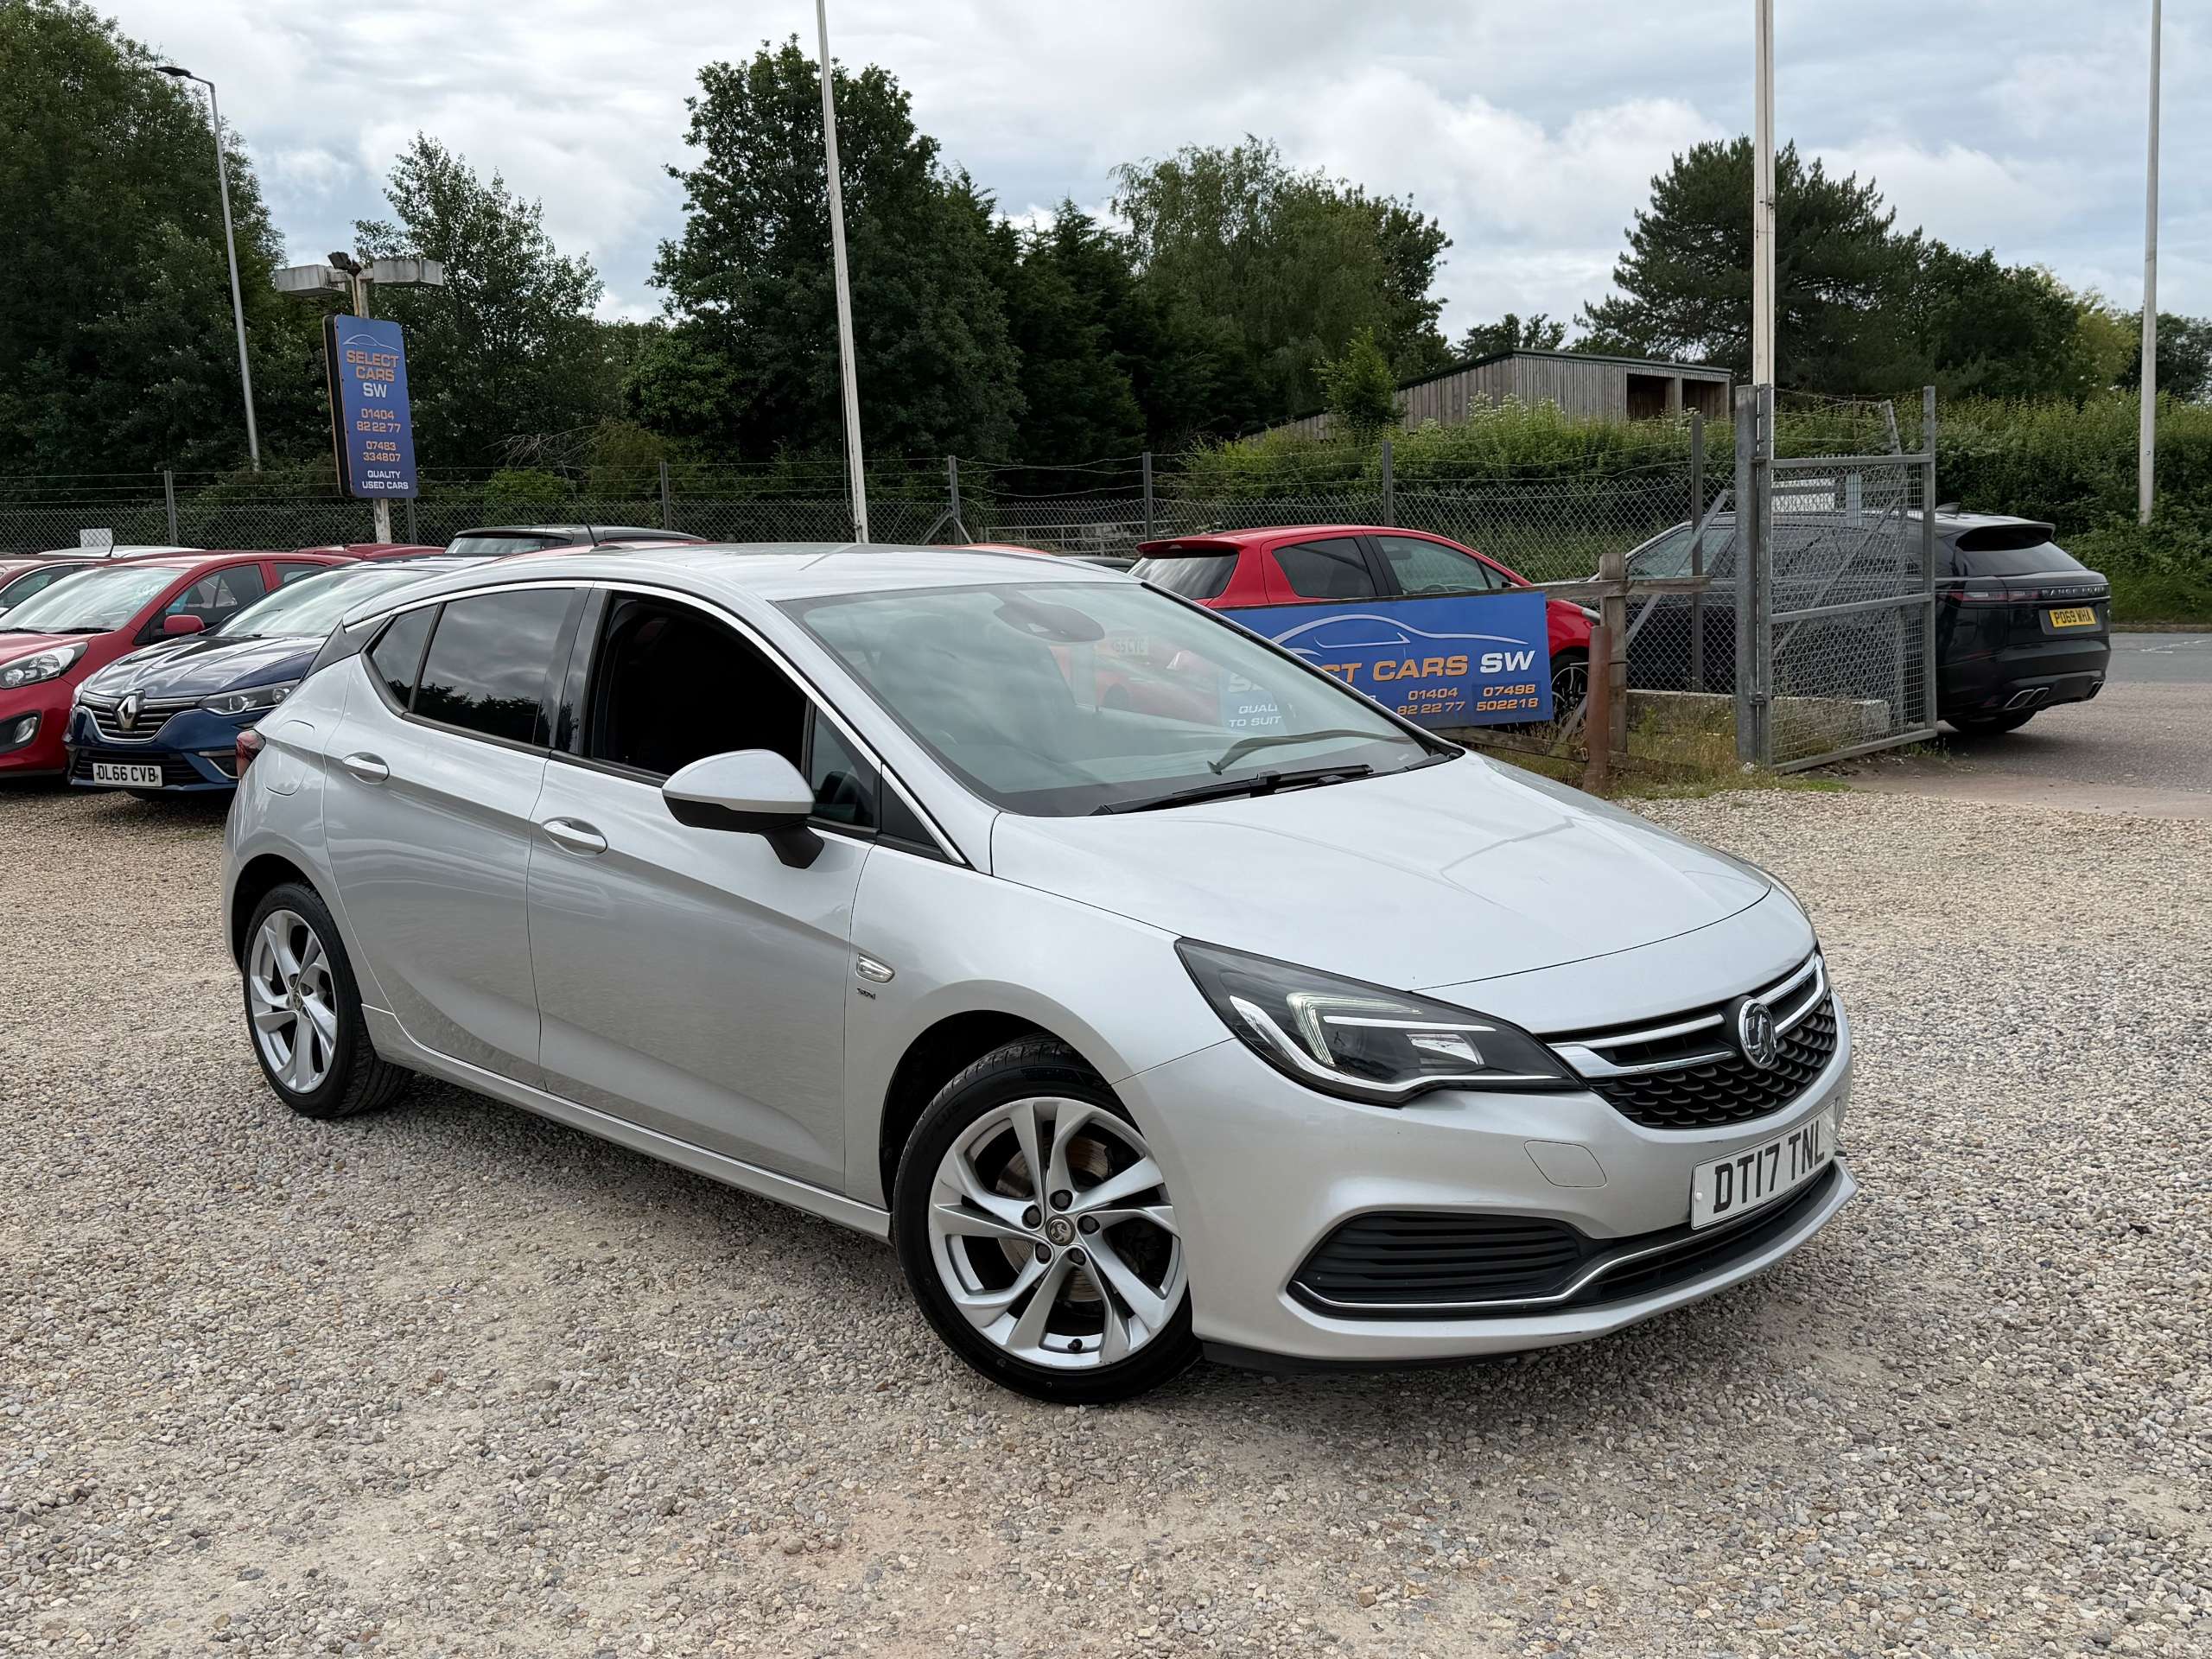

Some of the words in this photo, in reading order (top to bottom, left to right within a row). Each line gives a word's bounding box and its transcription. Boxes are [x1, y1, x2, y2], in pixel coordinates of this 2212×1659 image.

[346, 349, 399, 368] SELECT
[355, 365, 395, 382] CARS
[363, 383, 387, 398] SW
[360, 408, 395, 421] 01404
[362, 452, 401, 462] 334807
[367, 469, 401, 480] QUALITY
[362, 480, 385, 490] USED
[386, 481, 409, 490] CARS
[2053, 610, 2077, 625] PO69
[2076, 608, 2093, 623] WHA
[1372, 655, 1468, 682] CARS
[1479, 650, 1535, 673] SW
[1408, 687, 1459, 701] 01404
[1483, 683, 1535, 697] 07498
[1237, 703, 1279, 715] QUALI
[1396, 704, 1418, 716] 82
[1421, 702, 1442, 715] 22
[1445, 701, 1466, 712] 77
[1476, 697, 1539, 712] 502218
[1229, 719, 1246, 728] TO
[1250, 715, 1282, 727] SUIT
[98, 766, 128, 781] DL66
[130, 766, 156, 782] CVB
[1713, 1142, 1781, 1215] DT17
[1788, 1119, 1825, 1181] TNL
